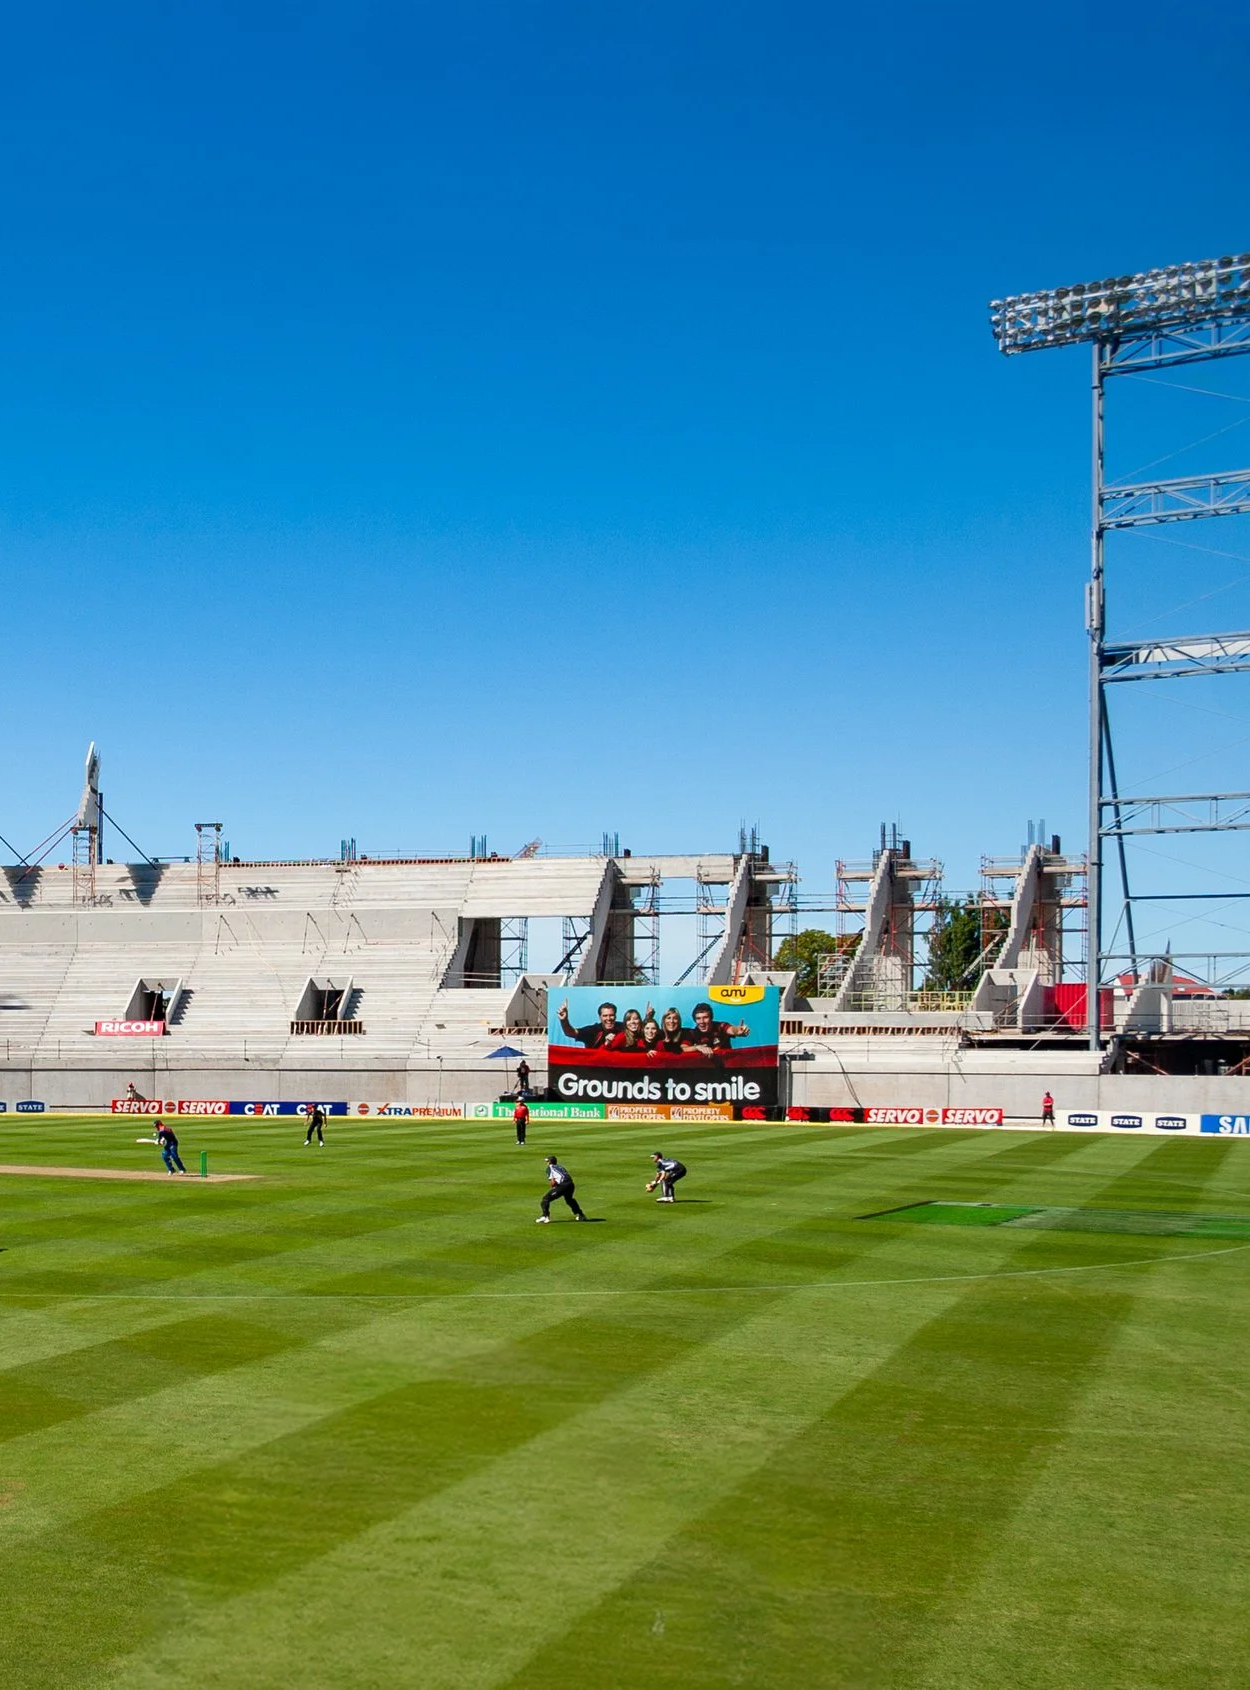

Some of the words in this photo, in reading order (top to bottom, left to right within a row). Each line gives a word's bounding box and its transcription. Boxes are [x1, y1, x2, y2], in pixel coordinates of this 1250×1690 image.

[100, 1022, 158, 1032] RICOH
[558, 1072, 660, 1100] Grounds
[665, 1078, 691, 1100] to
[694, 1076, 760, 1100] smile
[17, 1103, 43, 1111] STATE
[115, 1101, 160, 1114] SERVO
[181, 1102, 226, 1114] SERVO
[244, 1104, 280, 1116] CEAT
[296, 1104, 332, 1116] CAT
[527, 1106, 568, 1118] ational
[571, 1106, 600, 1118] Bank
[620, 1106, 657, 1114] PROPERTY
[868, 1109, 920, 1122] SERVO
[944, 1109, 1000, 1124] SERVO
[1070, 1116, 1097, 1124] STATE
[1112, 1118, 1141, 1126] STATE
[1156, 1120, 1185, 1128] STATE
